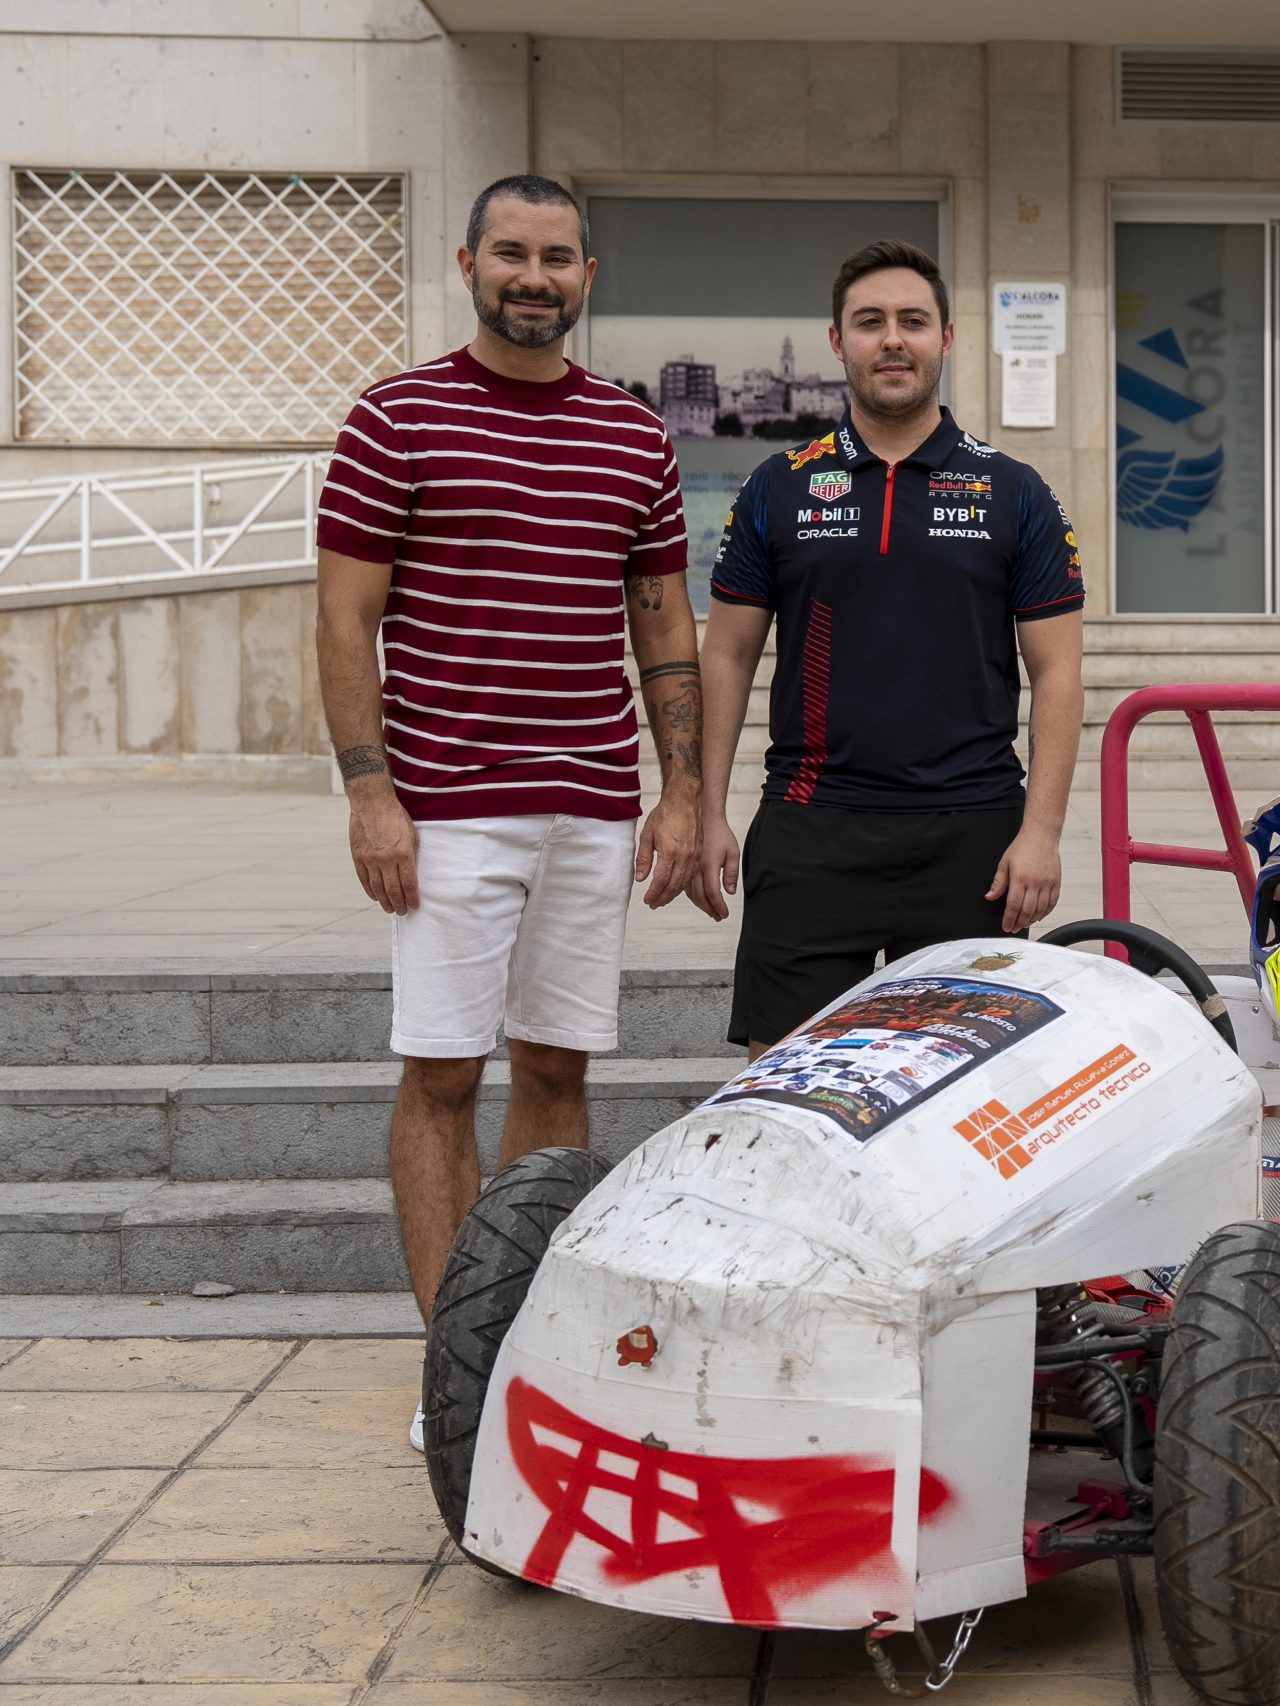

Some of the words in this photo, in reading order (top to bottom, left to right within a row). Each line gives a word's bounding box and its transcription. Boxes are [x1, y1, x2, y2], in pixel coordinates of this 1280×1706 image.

[838, 427, 858, 460] zoom
[814, 473, 848, 484] TAG
[929, 471, 992, 483] ORACLE
[811, 484, 849, 499] HEUER
[928, 491, 992, 500] RACING
[797, 507, 842, 523] Mobil
[933, 505, 987, 523] BYBIT
[797, 527, 859, 540] ORACLE
[928, 528, 992, 540] HONDA
[1027, 1097, 1102, 1155] arquitecto
[1099, 1062, 1152, 1101] técnico
